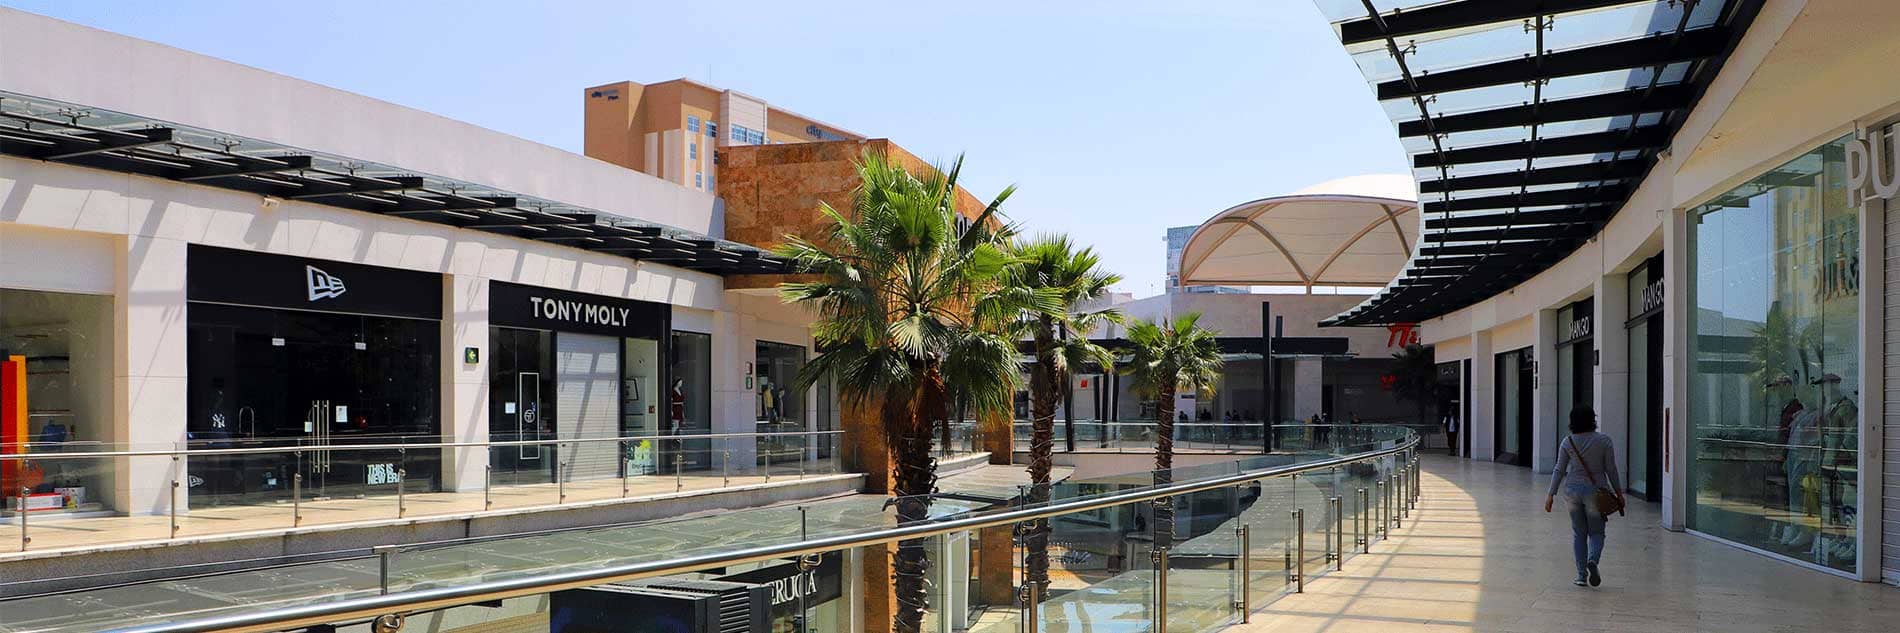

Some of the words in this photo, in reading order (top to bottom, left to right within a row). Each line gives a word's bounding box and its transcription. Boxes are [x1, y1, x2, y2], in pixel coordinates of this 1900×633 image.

[367, 464, 385, 474] THIS
[386, 463, 394, 474] IS
[368, 473, 385, 485] NEW
